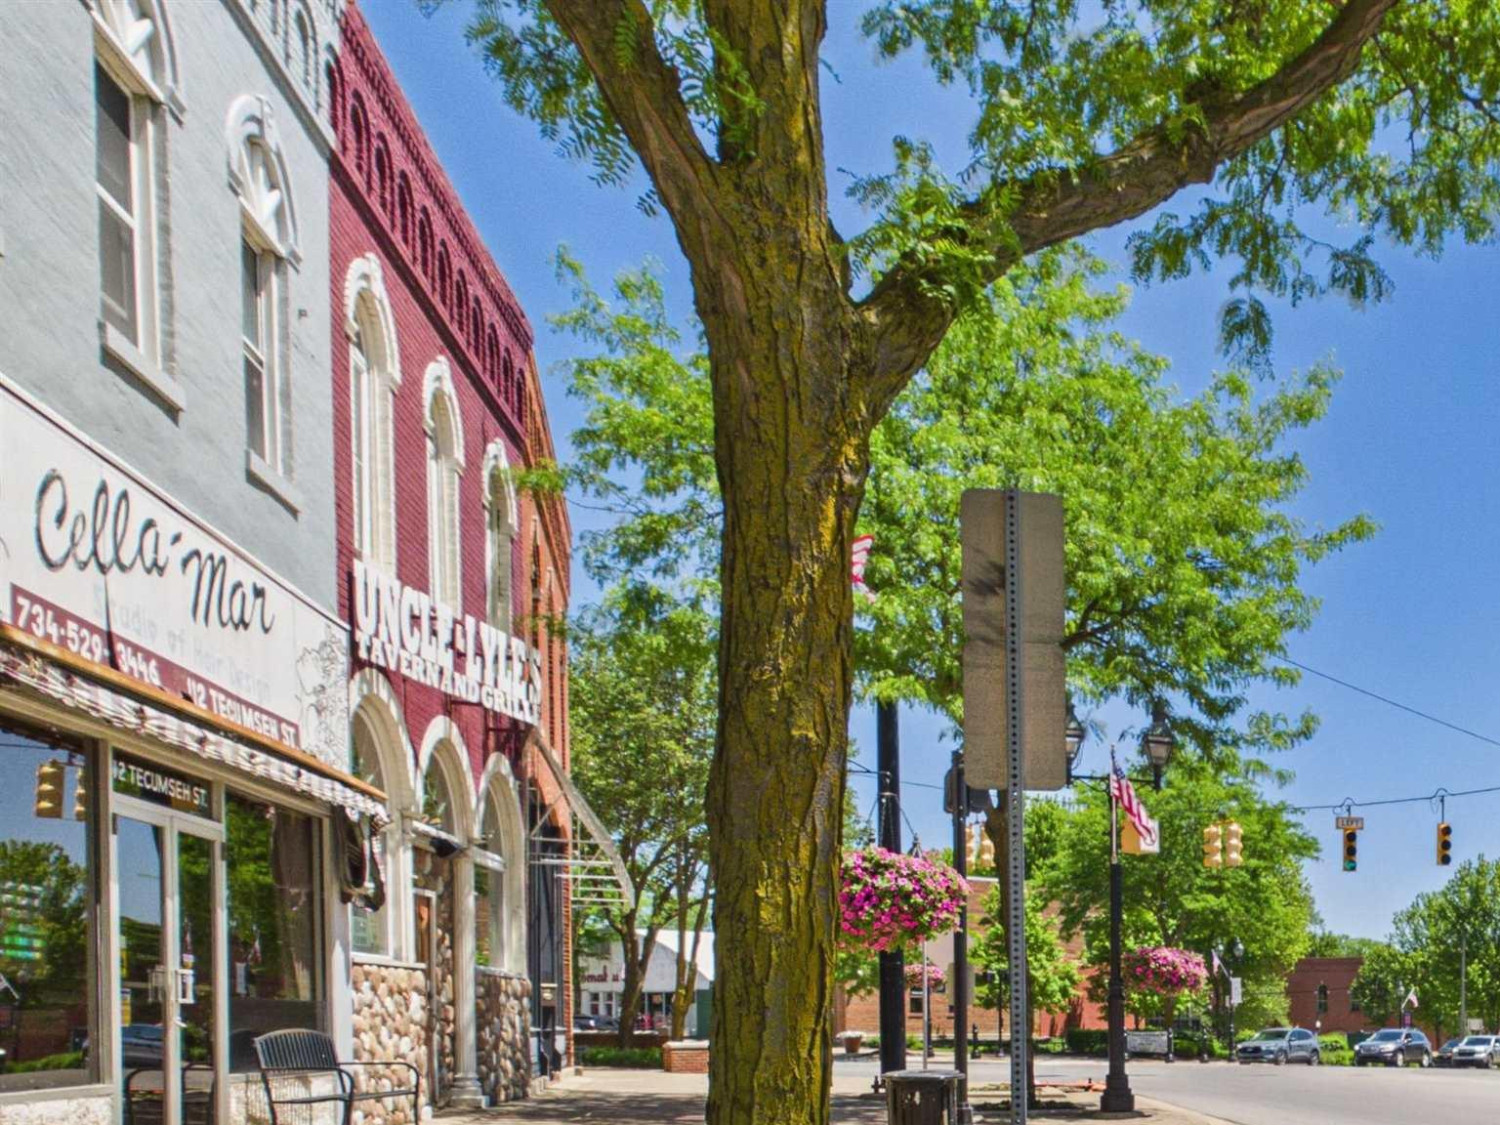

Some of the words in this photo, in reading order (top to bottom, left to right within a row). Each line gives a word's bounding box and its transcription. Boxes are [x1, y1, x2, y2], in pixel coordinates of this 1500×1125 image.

[353, 559, 454, 671] UNCLE
[355, 629, 442, 690] TAVERN
[440, 664, 481, 703] AND
[187, 677, 207, 709] 112
[209, 688, 280, 741] TECUMSEH
[128, 764, 191, 802] TECUMSEH
